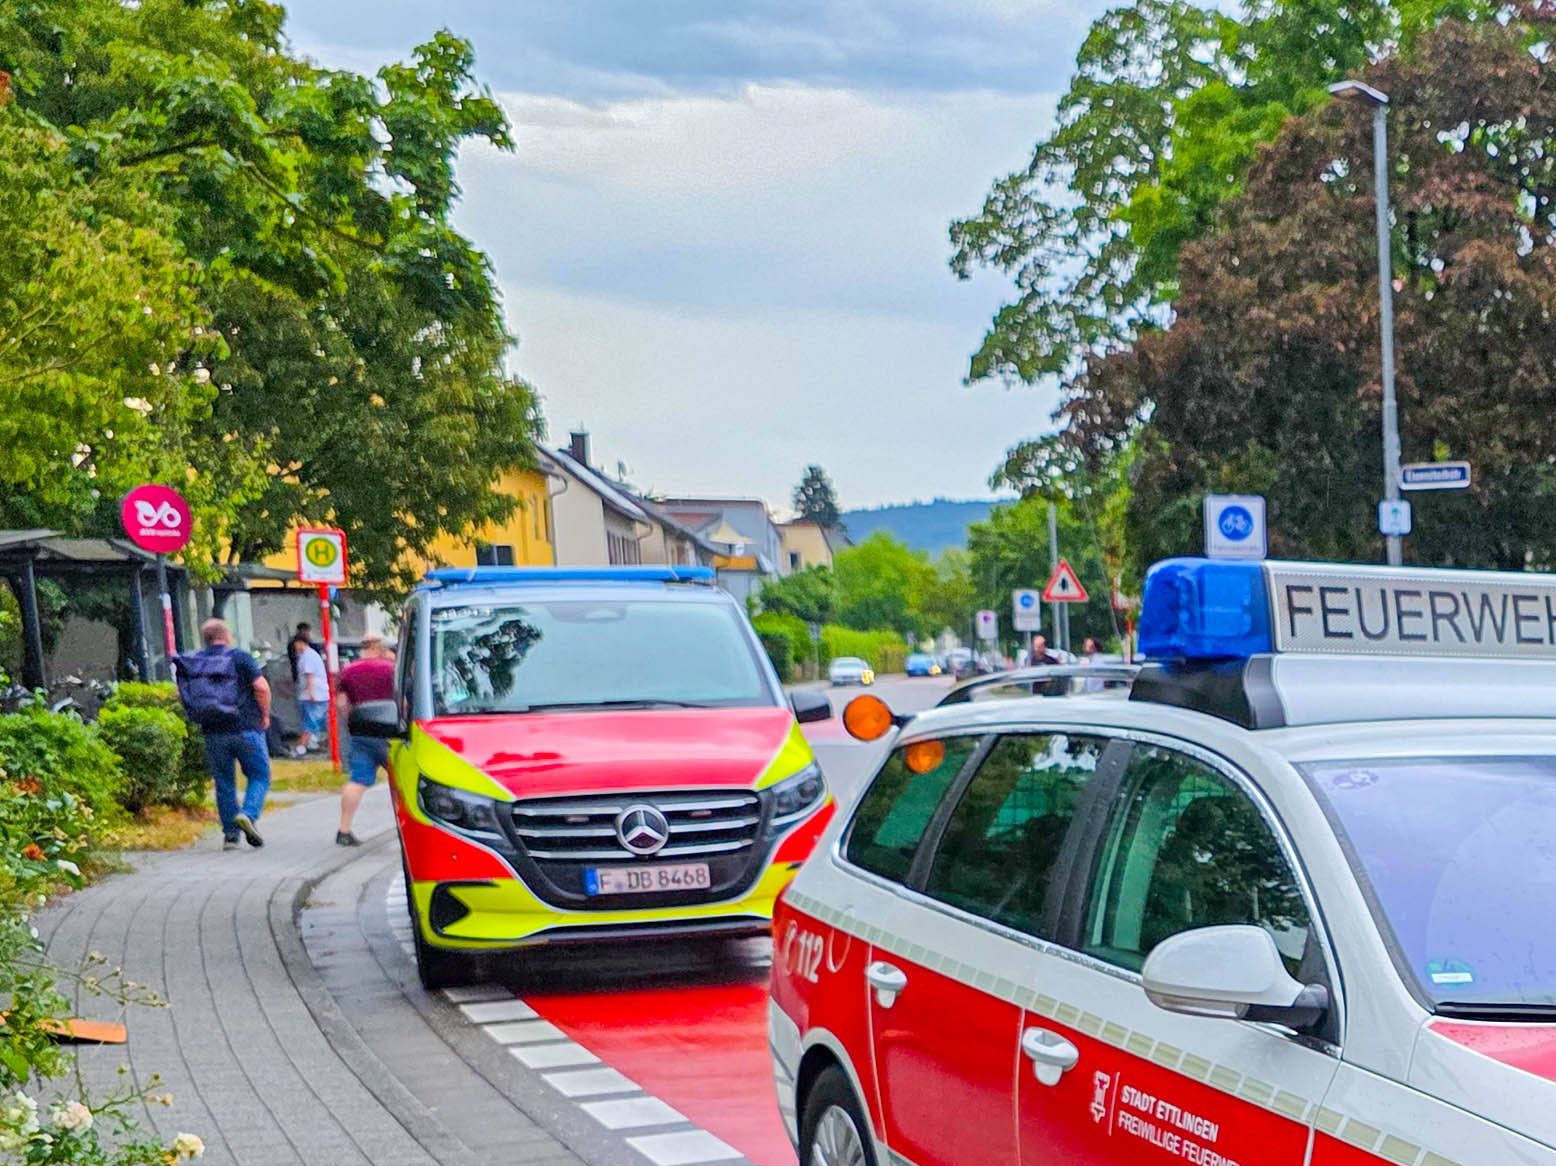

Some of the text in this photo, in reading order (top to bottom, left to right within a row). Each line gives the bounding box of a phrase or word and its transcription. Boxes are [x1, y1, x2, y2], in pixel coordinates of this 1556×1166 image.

[314, 543, 329, 561] H
[600, 868, 707, 889] F DB 8468
[796, 929, 824, 984] 112
[1117, 1110, 1182, 1155] FREIWILLIGE
[1121, 1085, 1219, 1142] STADT ETTLINGEN
